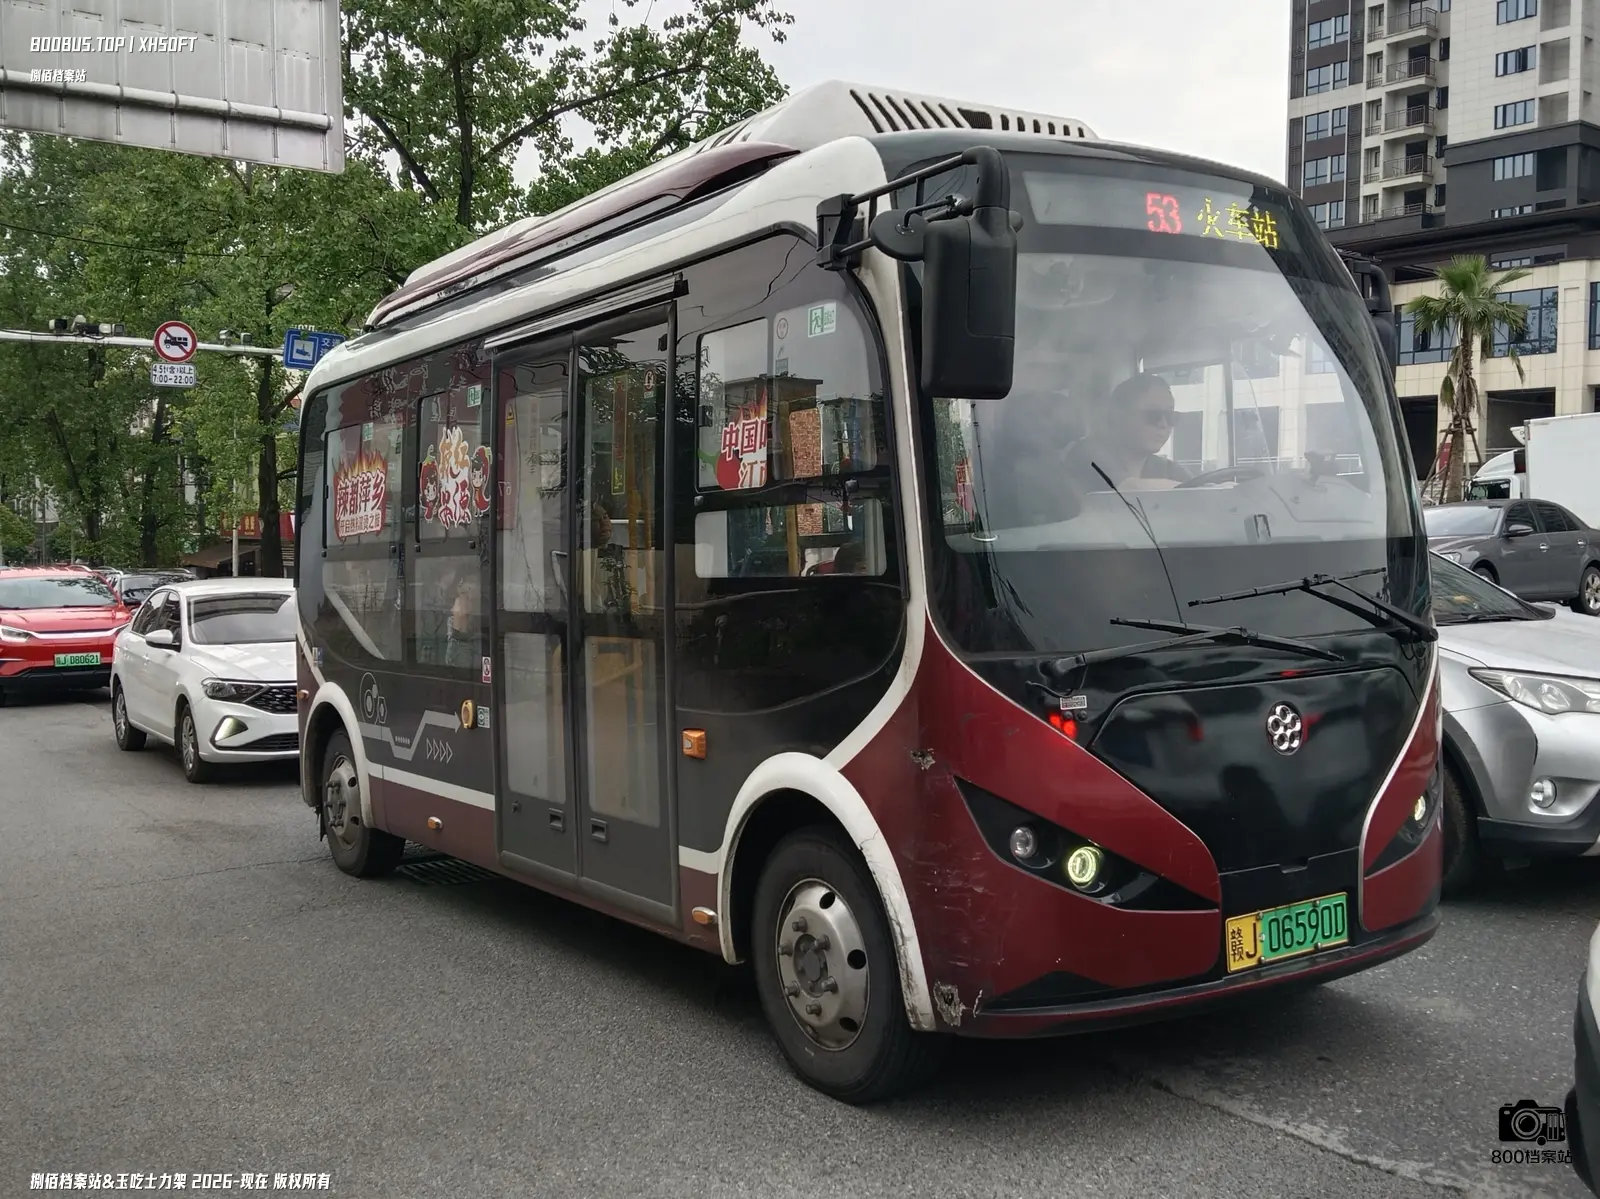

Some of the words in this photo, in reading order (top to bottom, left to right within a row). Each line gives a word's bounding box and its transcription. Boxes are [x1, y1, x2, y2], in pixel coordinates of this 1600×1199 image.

[1146, 191, 1182, 234] 53
[1197, 197, 1278, 249] 火车站
[337, 473, 385, 518] 辣都萍乡
[1268, 902, 1346, 953] 06590D
